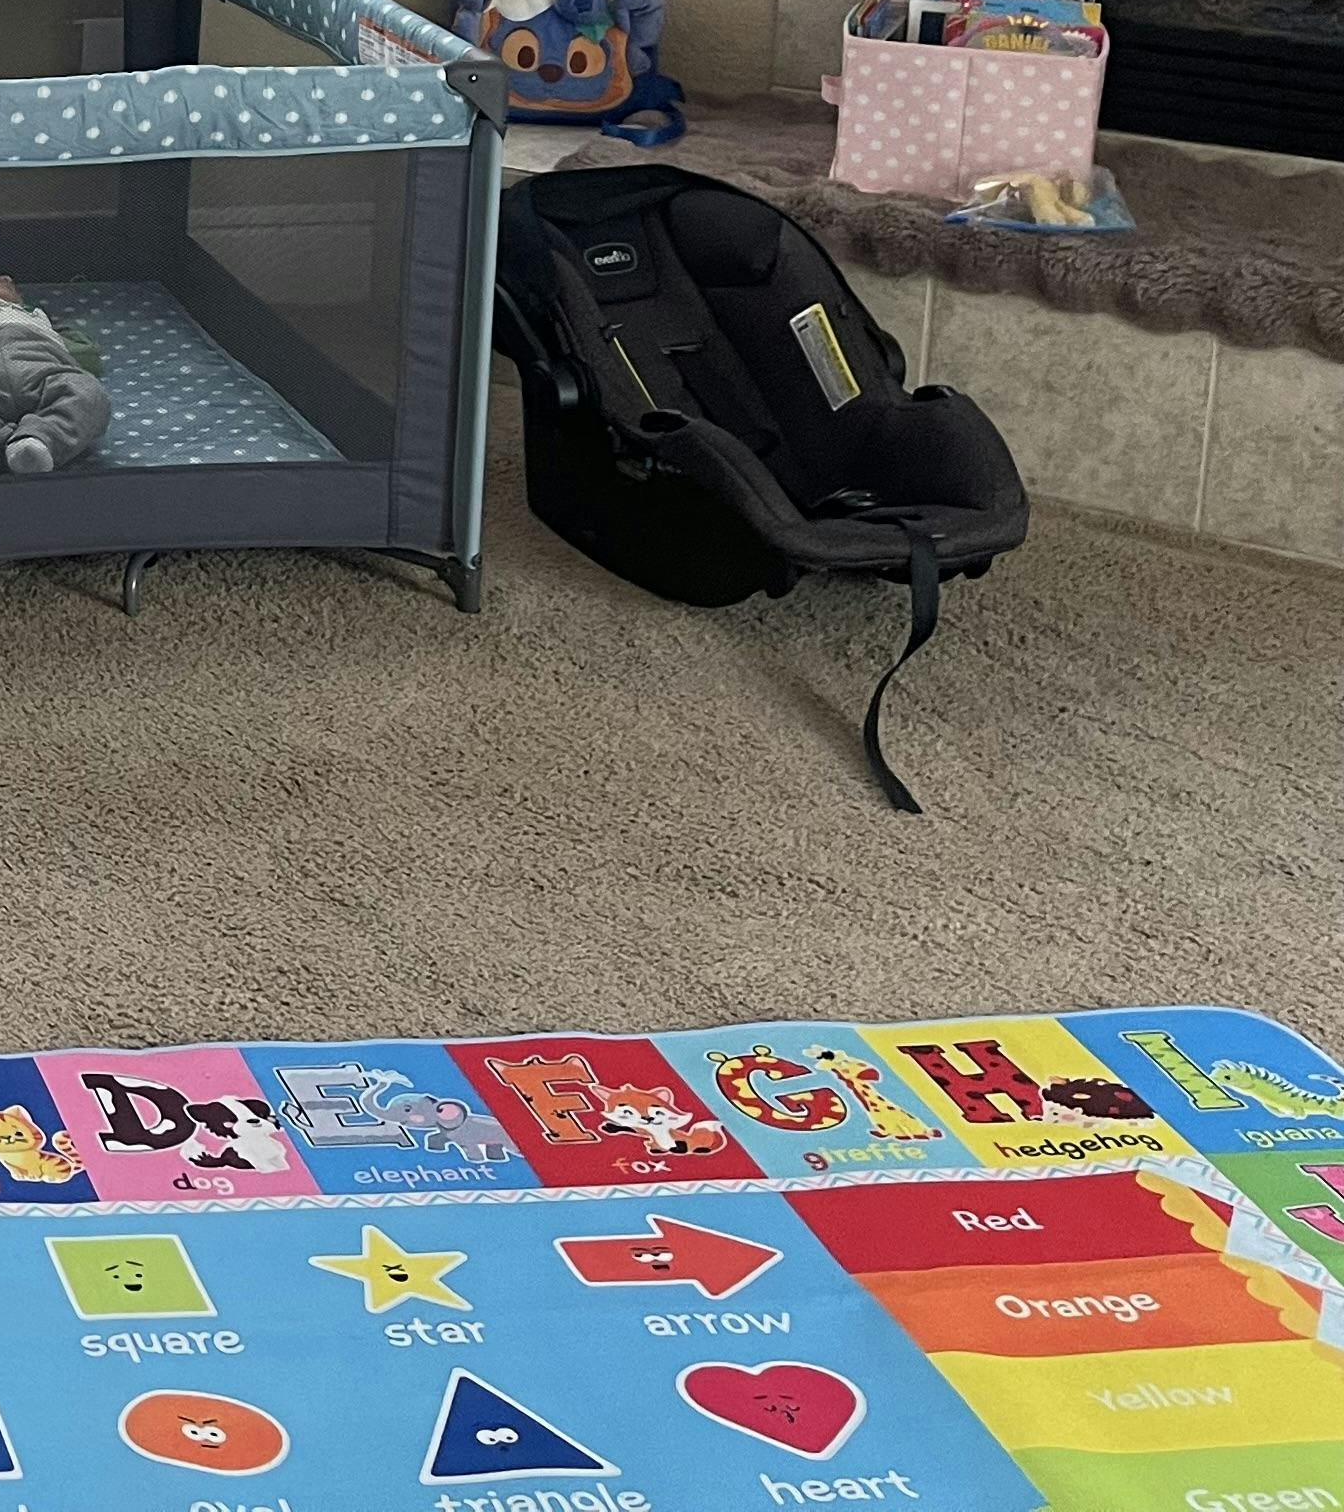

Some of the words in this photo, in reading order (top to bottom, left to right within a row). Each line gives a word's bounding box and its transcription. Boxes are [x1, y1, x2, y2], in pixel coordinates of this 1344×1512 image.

[896, 1039, 1047, 1124] H
[80, 1072, 198, 1153] D
[276, 1062, 415, 1148] E
[485, 1053, 602, 1145] F
[998, 1130, 1163, 1160] hedgehog
[1235, 1126, 1344, 1148] iguana
[612, 1157, 673, 1175] fox
[803, 1144, 928, 1171] giraffe
[172, 1172, 236, 1196] dog
[353, 1161, 498, 1189] elephant
[951, 1207, 1044, 1232] Red
[995, 1292, 1162, 1323] Orange
[383, 1316, 487, 1347] star
[643, 1310, 792, 1338] arrow
[79, 1328, 246, 1363] square
[1088, 1382, 1234, 1413] Yellow
[434, 1481, 652, 1512] triangle
[758, 1469, 920, 1506] heart
[1184, 1486, 1341, 1512] Green
